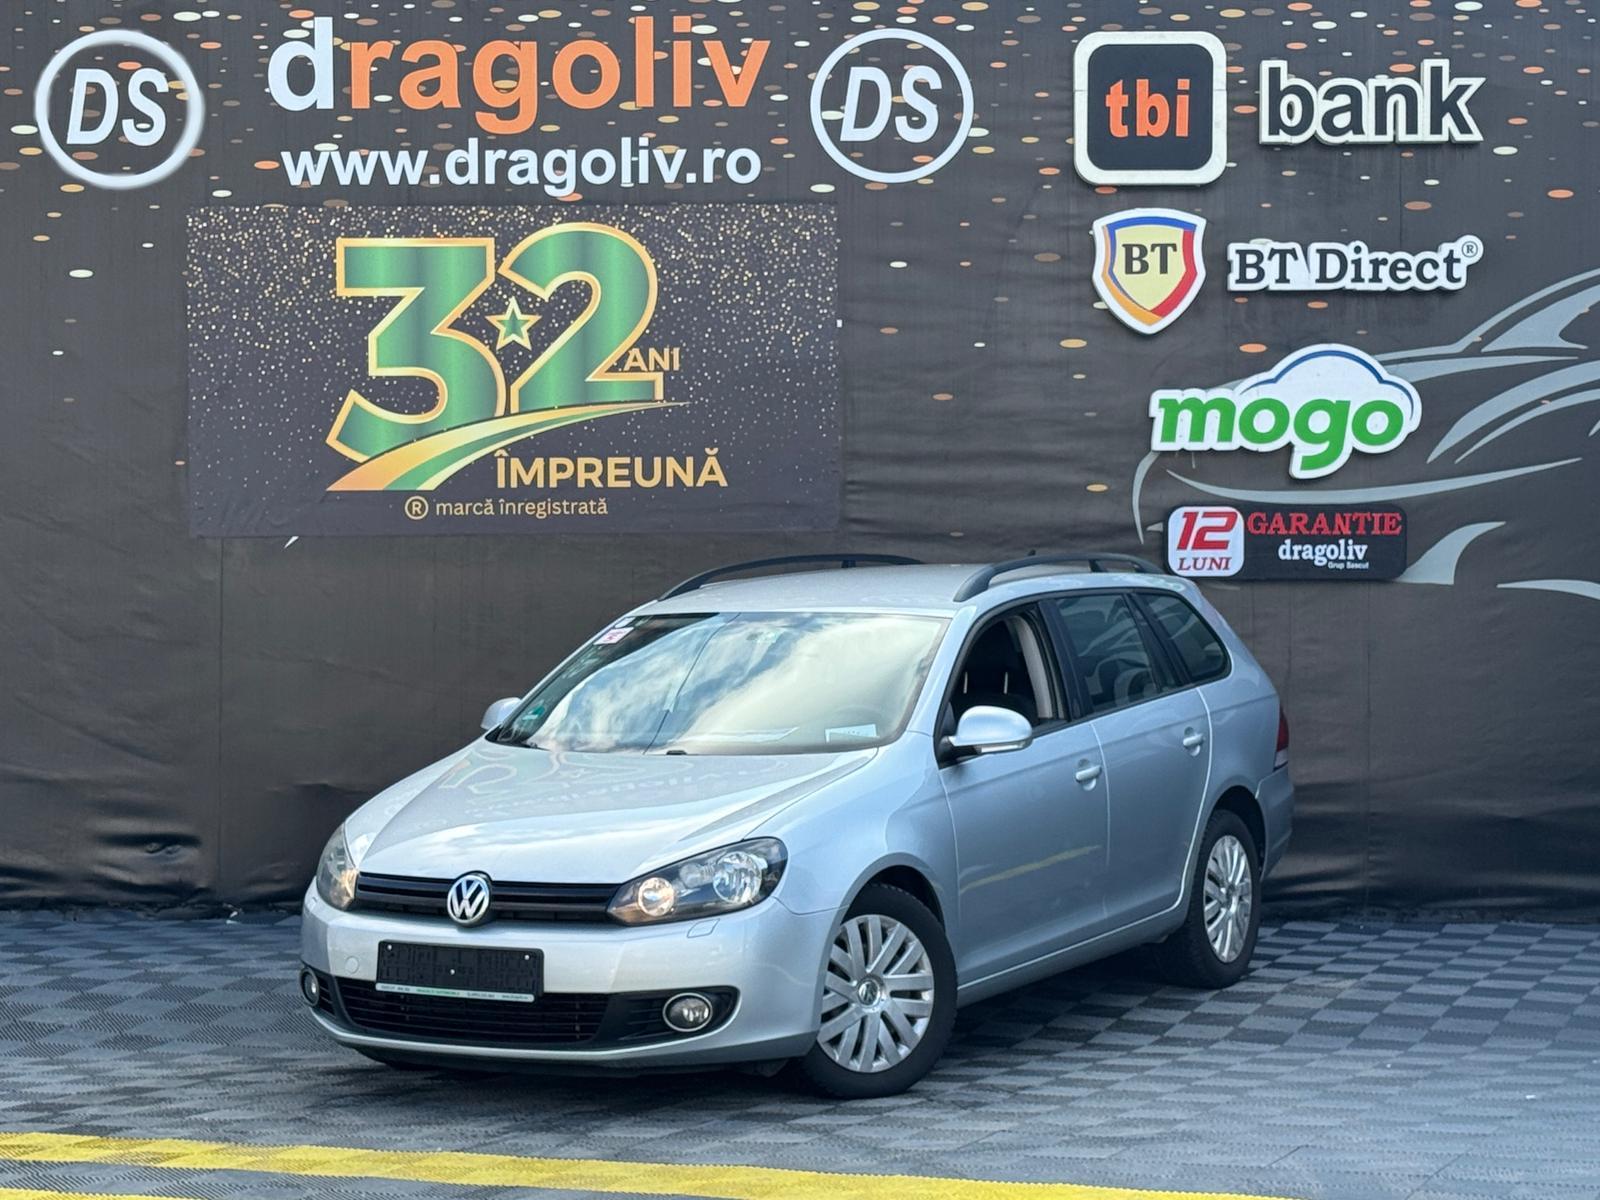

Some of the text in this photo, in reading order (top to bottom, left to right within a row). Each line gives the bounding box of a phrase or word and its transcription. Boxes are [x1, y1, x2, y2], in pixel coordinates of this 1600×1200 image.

[267, 15, 770, 135] dragoliv
[66, 67, 170, 147] DS
[839, 64, 944, 144] DS
[1105, 60, 1484, 144] tbi bank
[281, 136, 762, 198] www.dragoliv.ro
[1121, 242, 1178, 276] BT
[1235, 247, 1299, 284] BT
[326, 221, 664, 464] 32
[623, 347, 681, 372] ANI
[1157, 396, 1405, 472] mogo
[493, 447, 729, 489] ÎMPREUNĂ
[435, 498, 495, 517] marcă
[499, 497, 609, 519] înregistrată
[1176, 511, 1403, 551] 12 GARANTIE
[1176, 556, 1233, 572] LUNI
[1278, 538, 1369, 567] dragoliv
